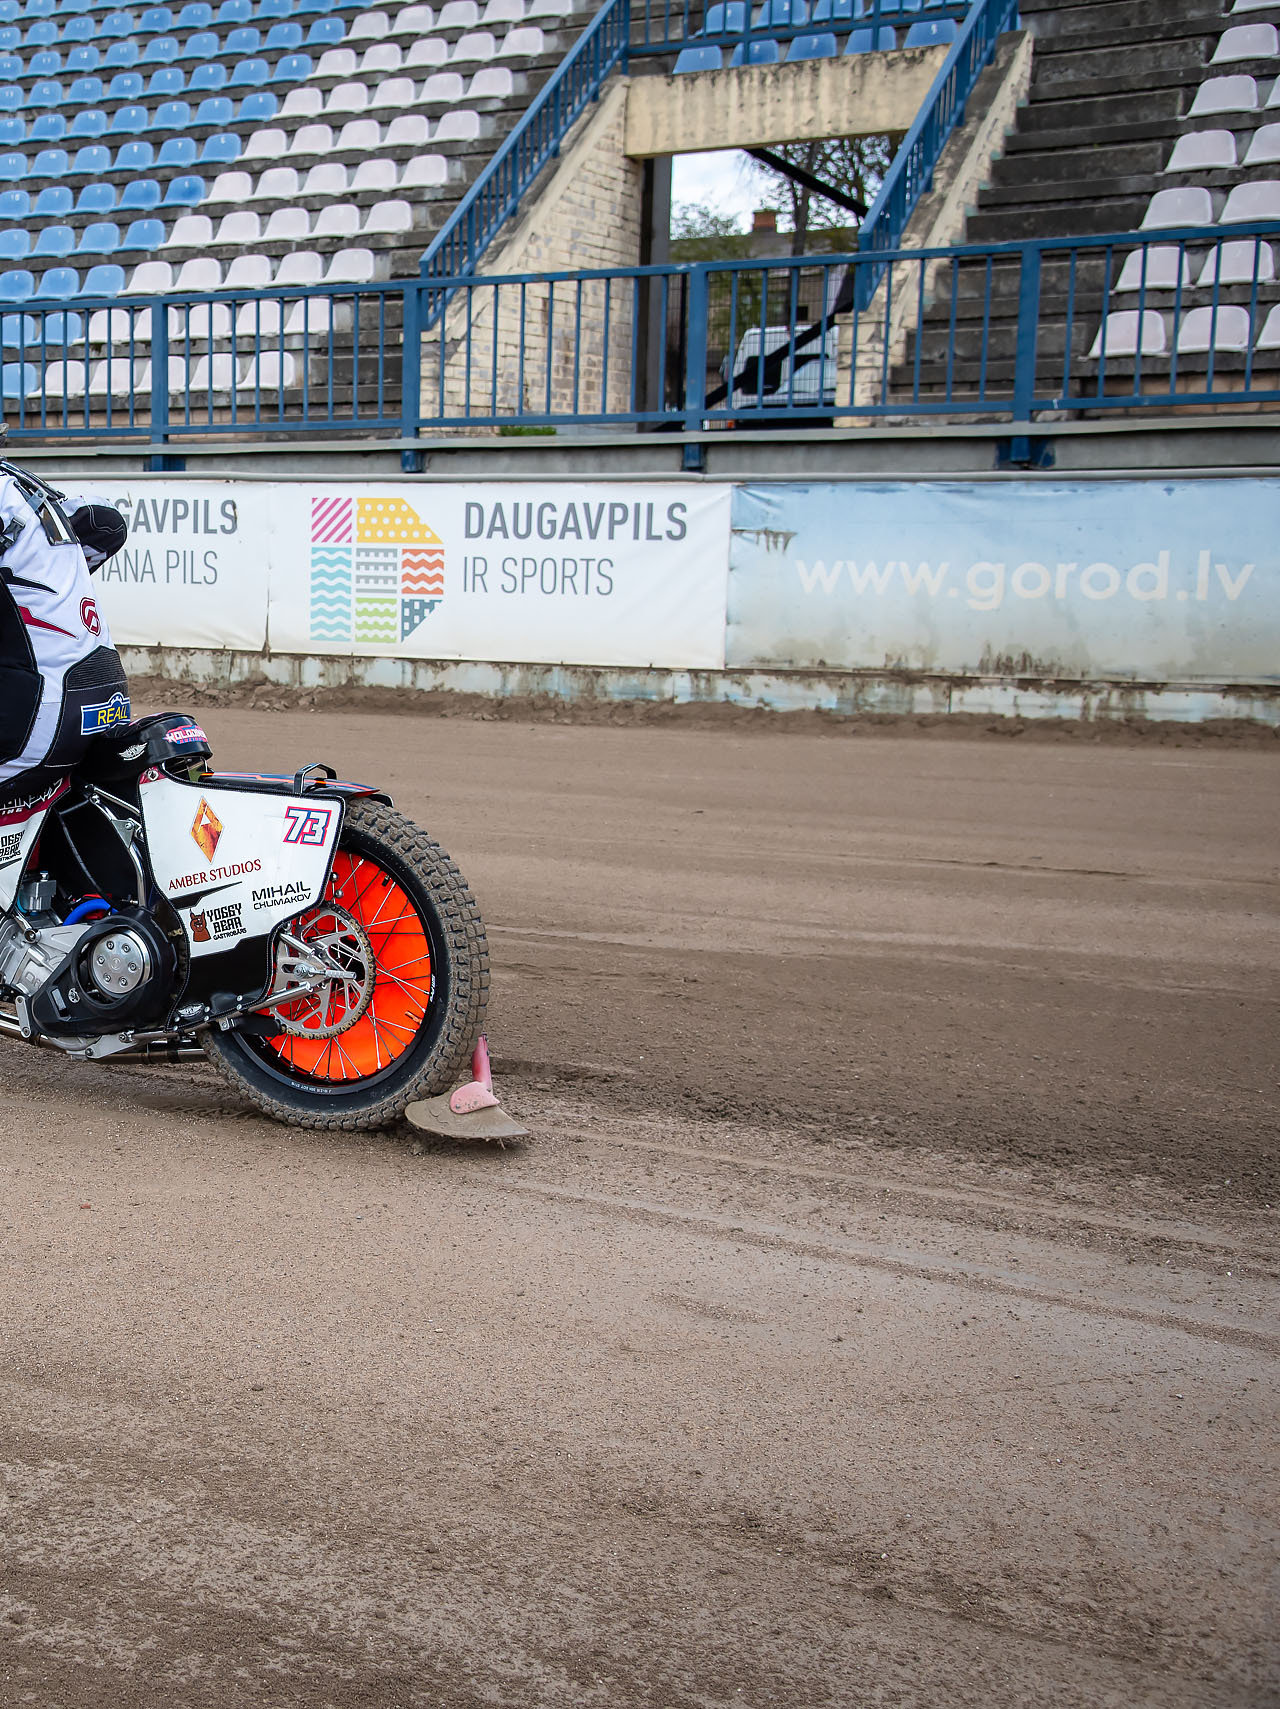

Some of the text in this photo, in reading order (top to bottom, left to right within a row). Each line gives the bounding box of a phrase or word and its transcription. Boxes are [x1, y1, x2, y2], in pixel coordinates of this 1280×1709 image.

[115, 498, 238, 535] GAVPILS
[464, 502, 687, 541] DAUGAVPILS
[166, 549, 218, 585] PILS
[463, 556, 614, 596] IR SPORTS
[795, 549, 1255, 611] www.gorod.lv
[97, 705, 128, 726] REALL
[283, 806, 332, 846] 73
[168, 859, 262, 891] AMBER STUDIOS
[252, 880, 311, 902] MIHAIL
[206, 902, 242, 922] YOGGY
[253, 892, 311, 911] CHUMAKOV
[213, 916, 242, 934] BEAR
[213, 927, 247, 941] GASTROBARS
